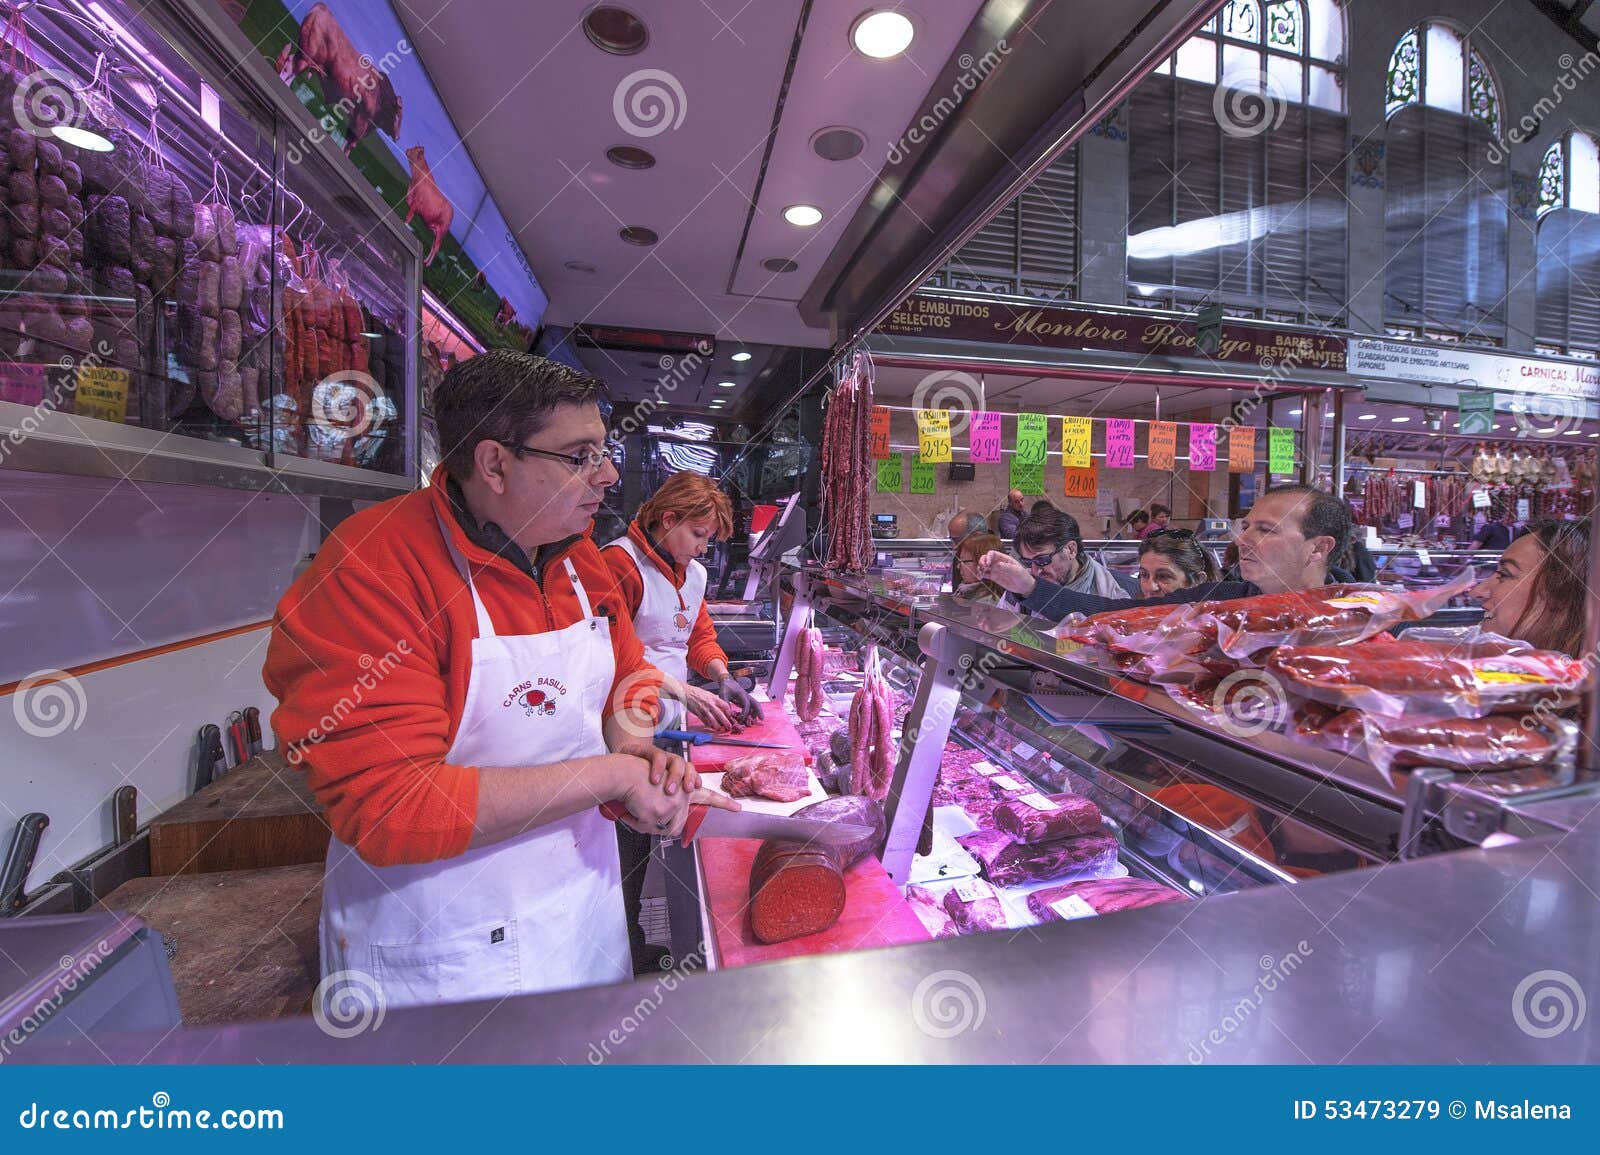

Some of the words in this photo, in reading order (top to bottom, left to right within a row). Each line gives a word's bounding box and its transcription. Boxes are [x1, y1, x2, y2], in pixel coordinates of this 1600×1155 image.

[906, 299, 915, 312] Y
[920, 301, 990, 318] EMBUTIDOS
[892, 312, 952, 328] SELECTOS
[994, 310, 1128, 341] Montoro
[1141, 323, 1251, 359] Roigo
[1275, 335, 1314, 349] BARES
[1318, 338, 1326, 350] Y
[1255, 345, 1344, 363] RESTAURANTES
[1358, 342, 1382, 351] CARNES
[1383, 344, 1409, 354] FRESCAS
[1410, 347, 1440, 357] SELECTAS
[1358, 361, 1385, 371] JAMONES
[1400, 356, 1409, 364] DE
[1440, 361, 1470, 371] ARTESANO
[1520, 365, 1567, 381] CARNICAS
[503, 680, 532, 708] CARNS
[537, 677, 567, 696] BASILIO
